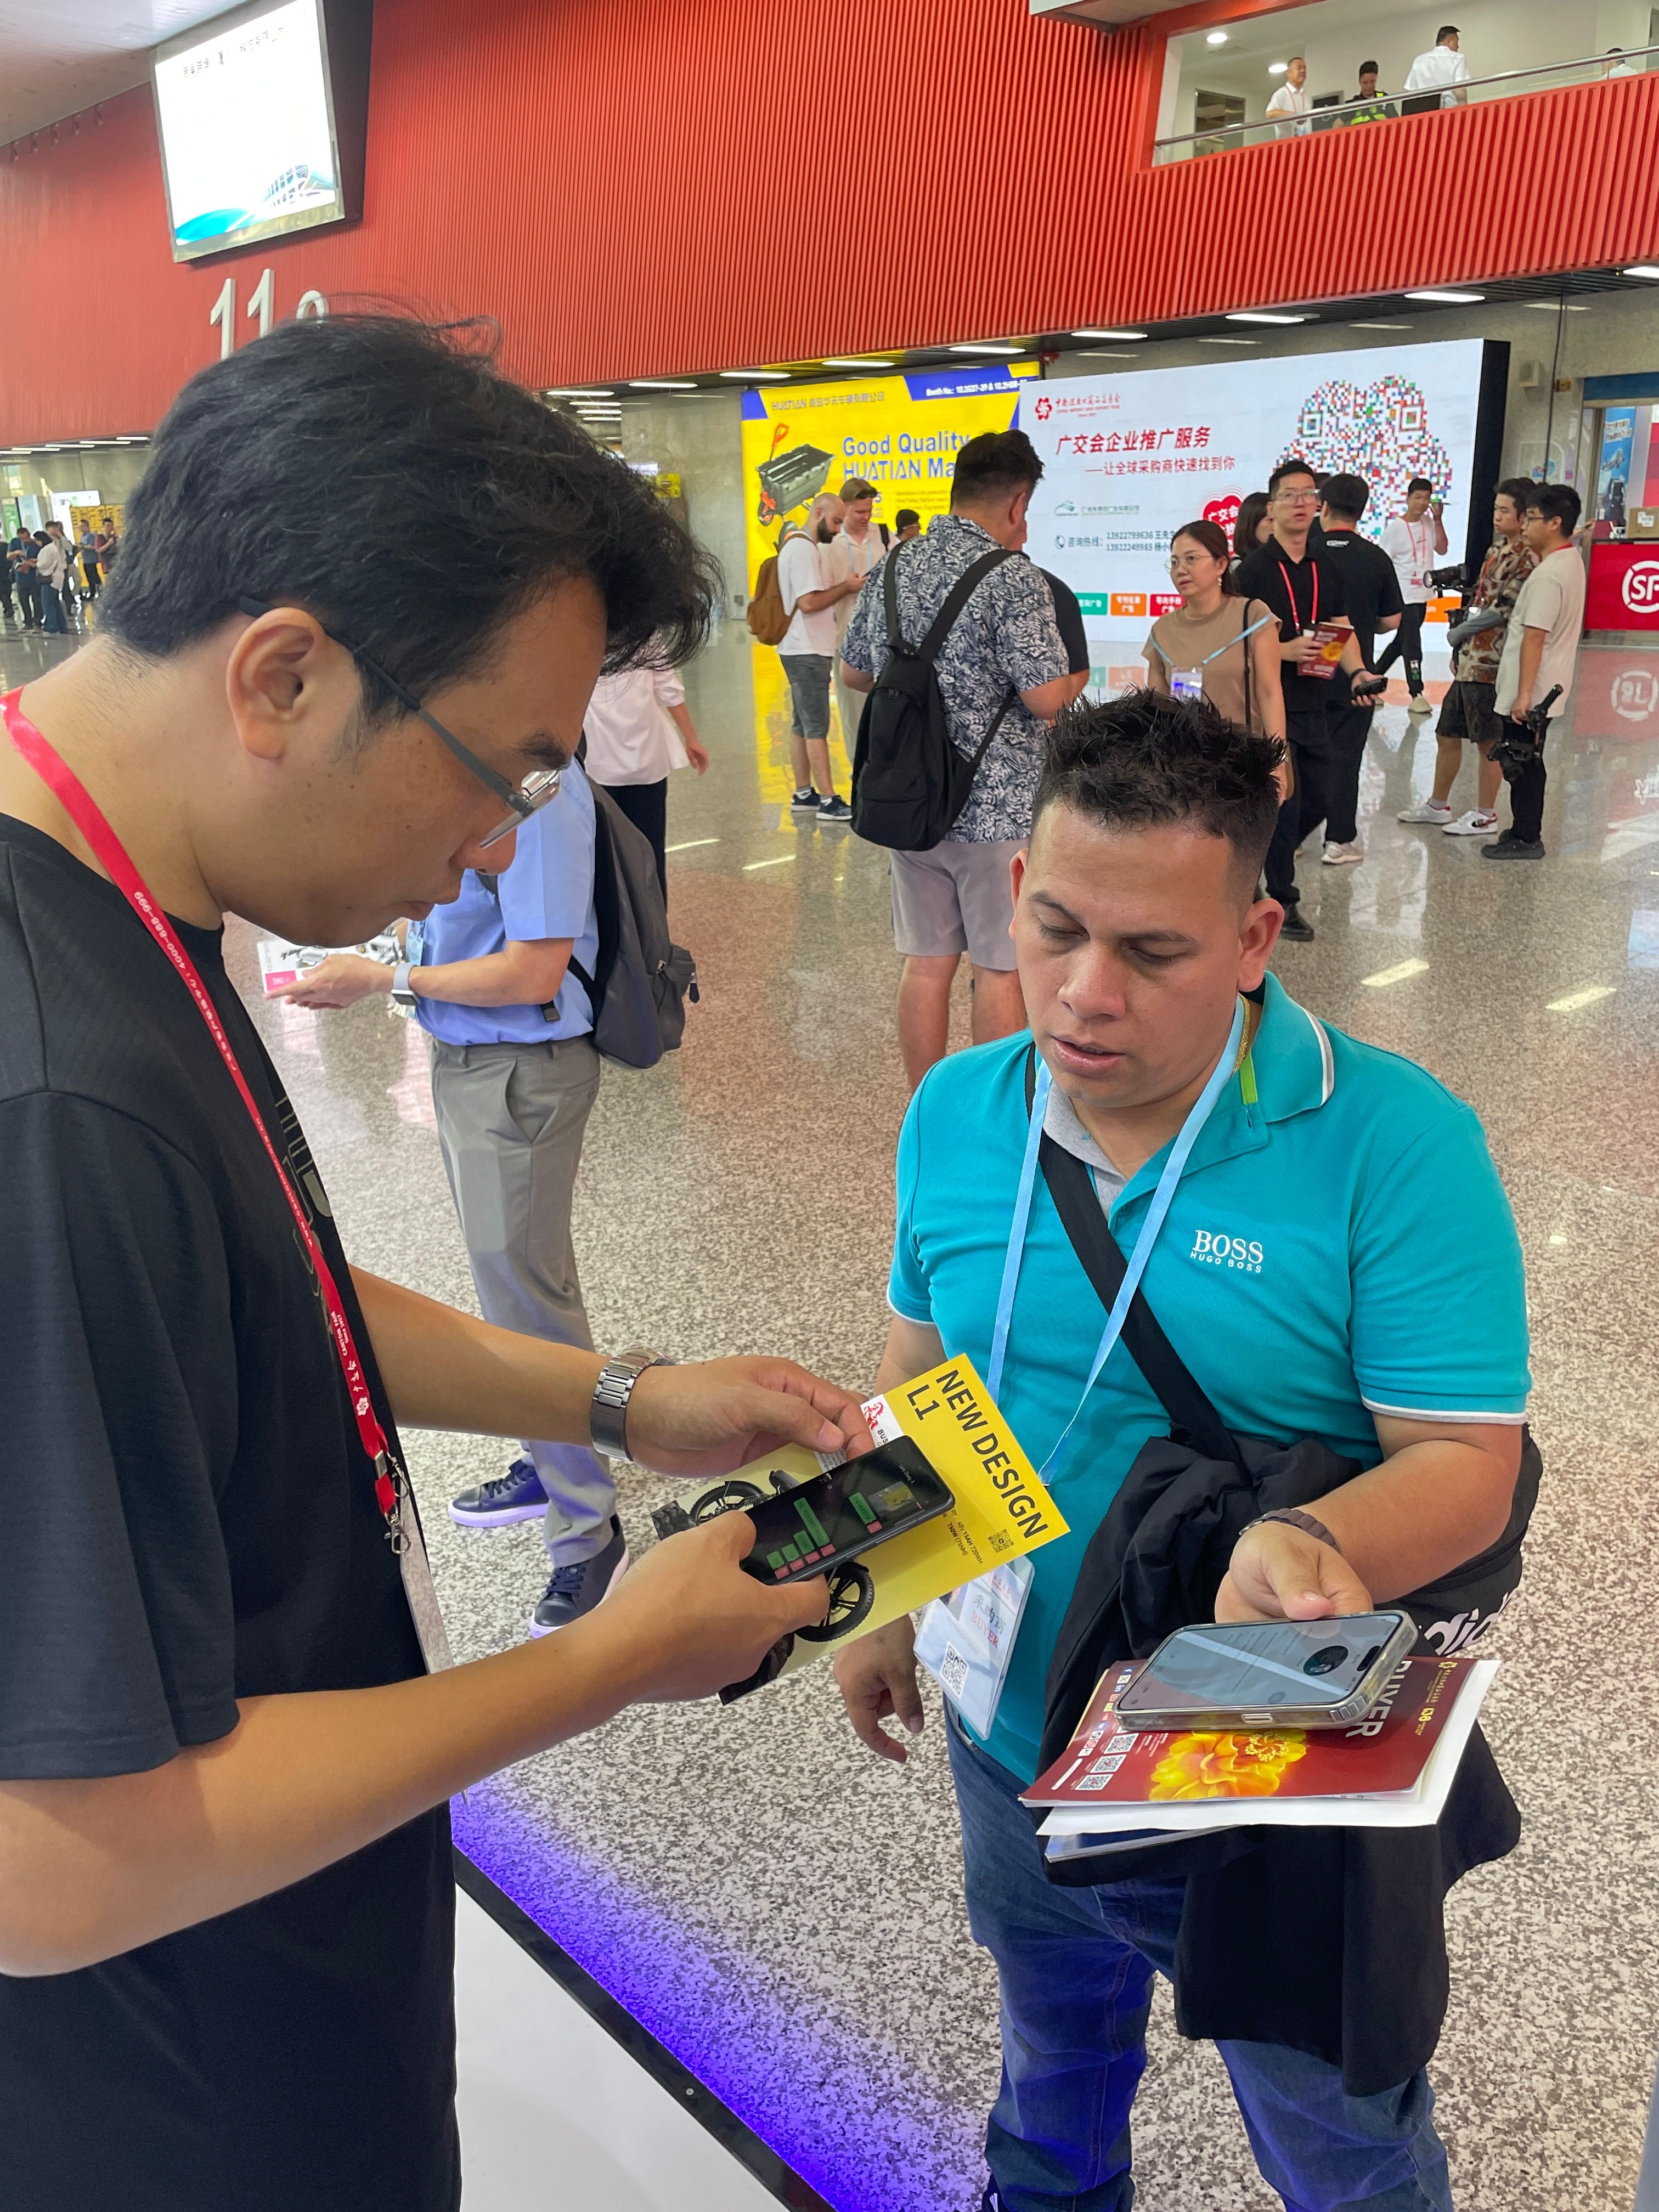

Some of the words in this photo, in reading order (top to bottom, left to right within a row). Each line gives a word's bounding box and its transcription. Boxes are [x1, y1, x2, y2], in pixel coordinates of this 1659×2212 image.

[843, 434, 890, 457] Good
[898, 430, 971, 454] Quality
[1054, 425, 1211, 456] 广交会企业推广服务
[843, 458, 921, 482] HUATIAN
[133, 891, 186, 969] 4000-888-999
[1189, 1251, 1222, 1265] HUGO
[1227, 1259, 1262, 1273] BOSS
[1192, 1229, 1263, 1264] BOSS
[336, 1328, 348, 1356] CANTON
[906, 1384, 940, 1421] L1
[935, 1369, 989, 1432] NEW
[971, 1432, 1050, 1539] DESIGN
[947, 1522, 959, 1537] 750W
[955, 1537, 969, 1556] (75NM)
[963, 1531, 974, 1546] 15AH
[970, 1545, 984, 1565] 720WH
[971, 1610, 999, 1650] BUYER
[973, 1594, 1007, 1636] 采购商
